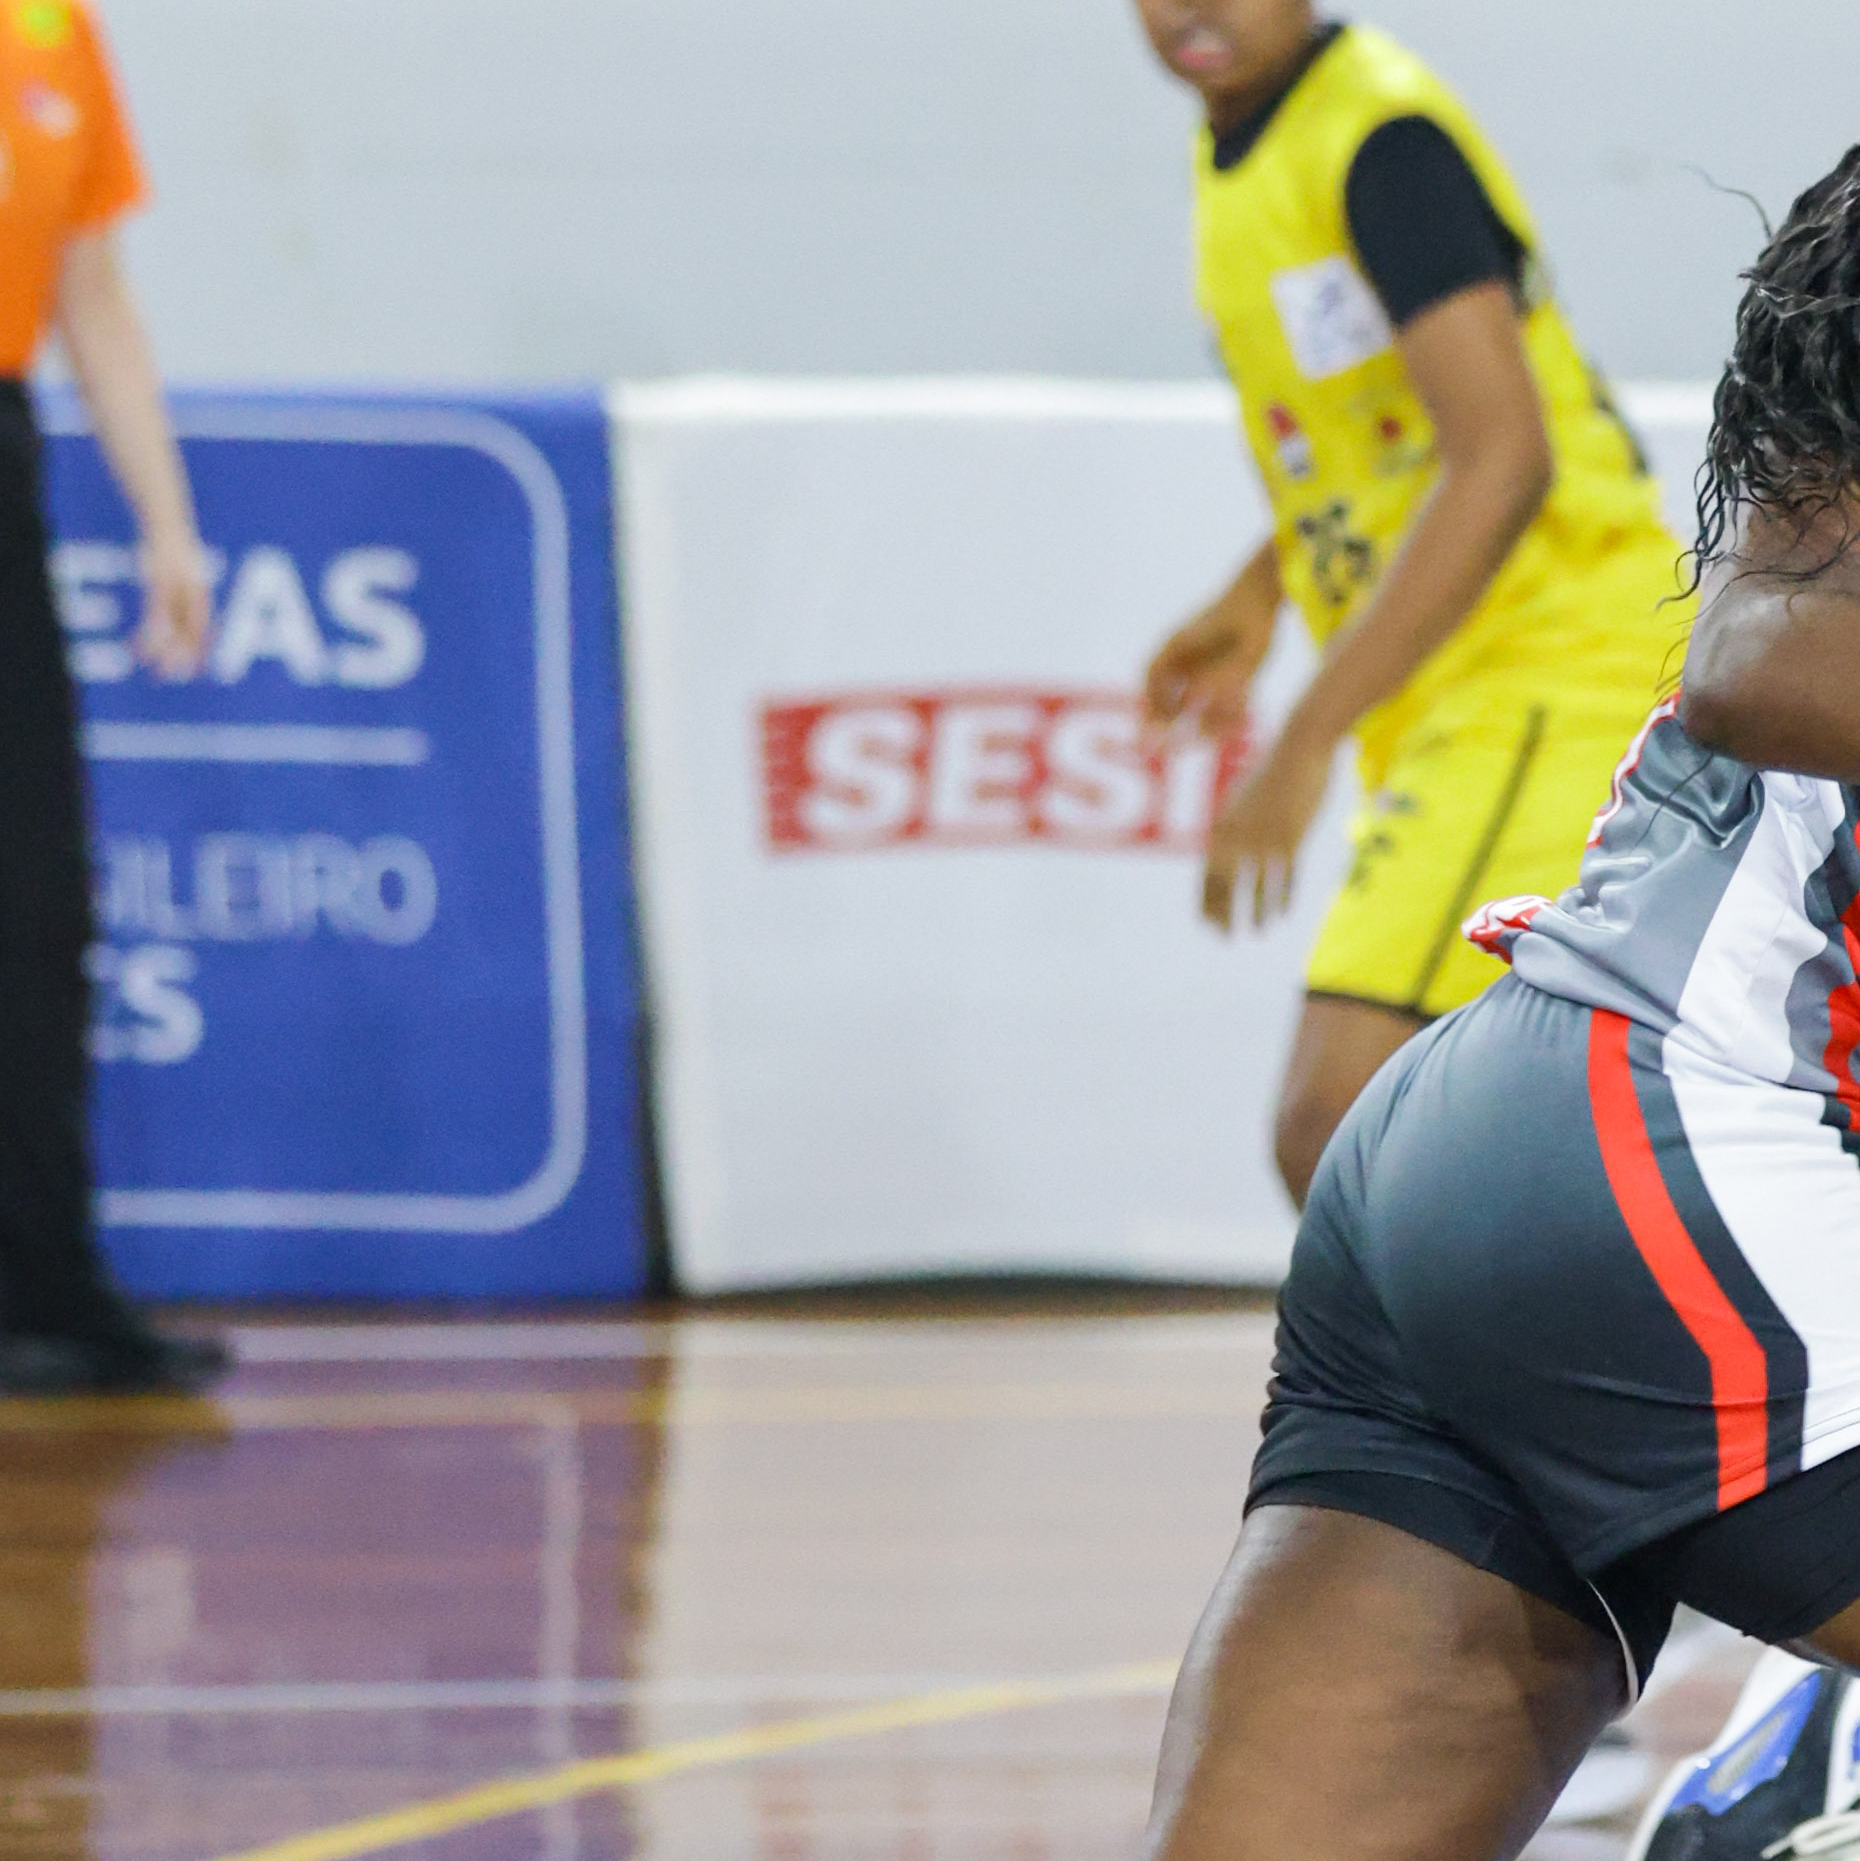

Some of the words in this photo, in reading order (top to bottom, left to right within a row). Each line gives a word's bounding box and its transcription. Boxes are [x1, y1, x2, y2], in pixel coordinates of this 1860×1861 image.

[46, 543, 427, 689] EAS
[805, 705, 1220, 835] SESI
[91, 830, 438, 946] ILEIRO
